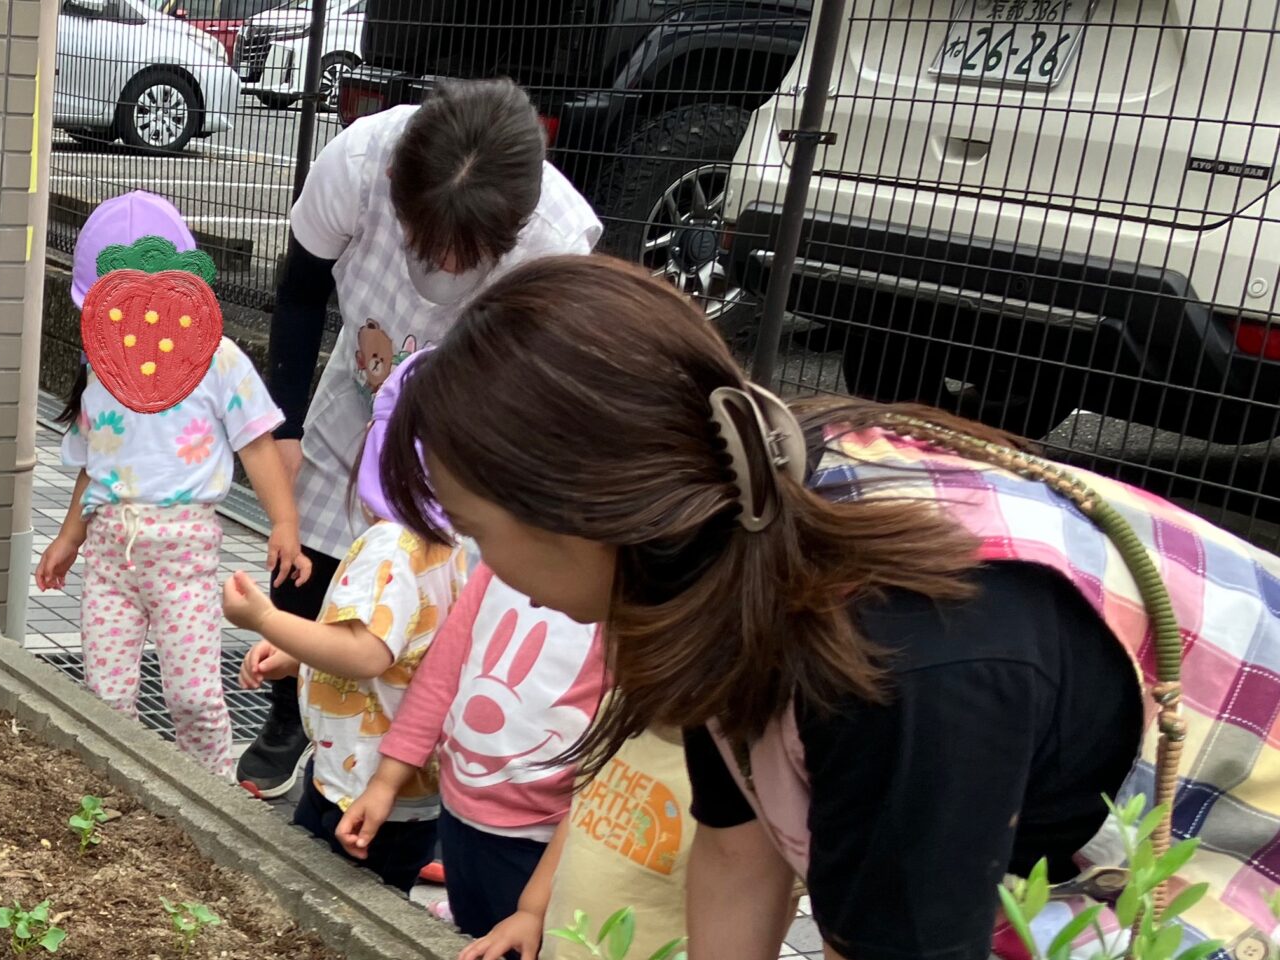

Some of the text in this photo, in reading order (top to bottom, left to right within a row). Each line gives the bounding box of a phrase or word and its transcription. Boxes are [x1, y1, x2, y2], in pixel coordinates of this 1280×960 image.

[986, 0, 1027, 21] 京都
[962, 27, 1071, 77] 26-26
[1191, 160, 1265, 177] KYOO NISAN
[606, 756, 654, 800] THE
[578, 779, 641, 826] ORTH
